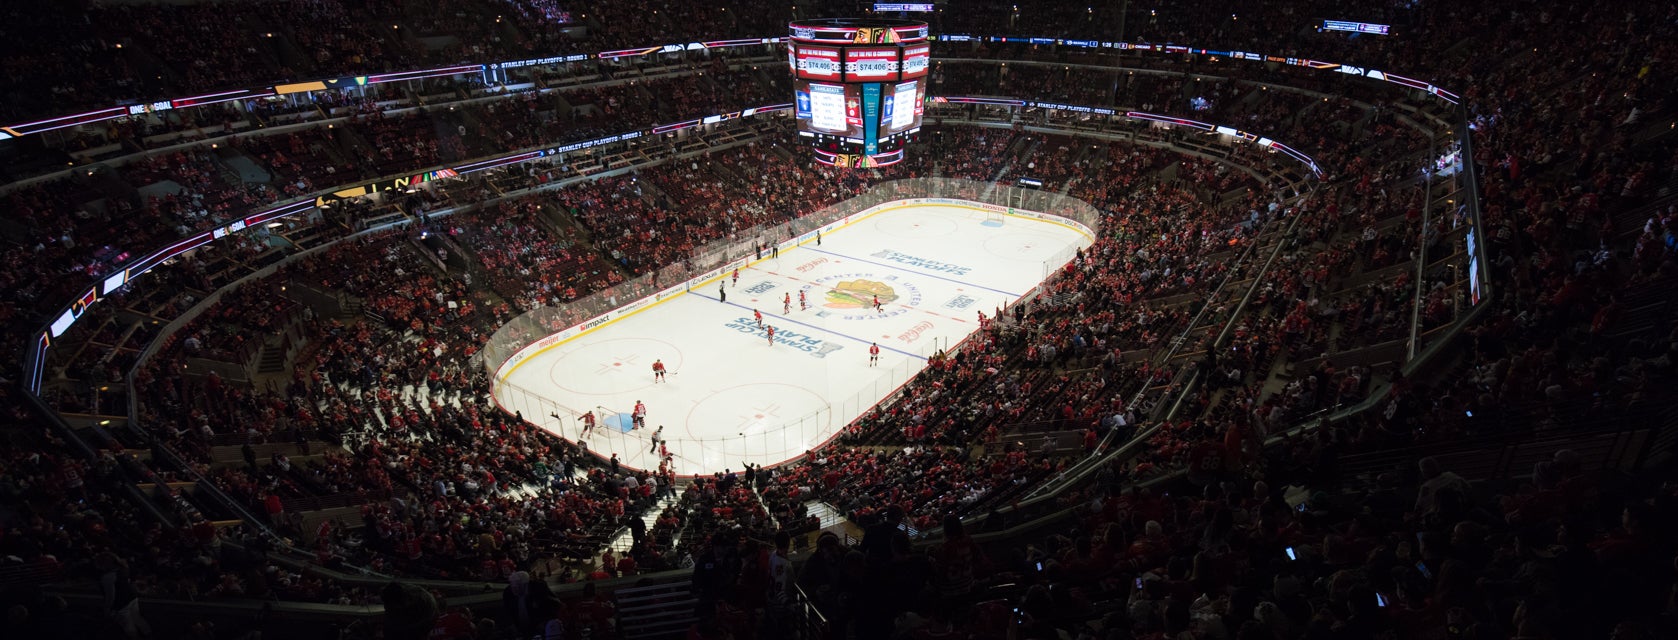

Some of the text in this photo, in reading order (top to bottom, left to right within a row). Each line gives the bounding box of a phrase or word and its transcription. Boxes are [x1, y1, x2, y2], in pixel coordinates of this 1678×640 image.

[501, 61, 525, 69] STANLEY
[537, 57, 562, 65] PLAYOFFS
[566, 54, 584, 62] ROUND
[859, 63, 887, 71] $74,406
[129, 100, 173, 115] ONE GOAL
[1067, 105, 1091, 113] PLAYOFFS
[558, 143, 581, 153] STANLEY
[593, 136, 618, 146] PLAYOFFS
[621, 132, 638, 140] ROUND
[982, 204, 1007, 213] HONDA
[213, 220, 246, 239] ONE GOAL
[887, 256, 967, 276] PLAYOFFS
[903, 282, 922, 307] UNITED
[954, 297, 975, 309] BUD
[585, 315, 610, 330] impact
[843, 309, 908, 321] CENTER
[724, 322, 756, 333] CUP
[898, 320, 935, 344] Coca-Cola
[539, 335, 559, 349] meijer
